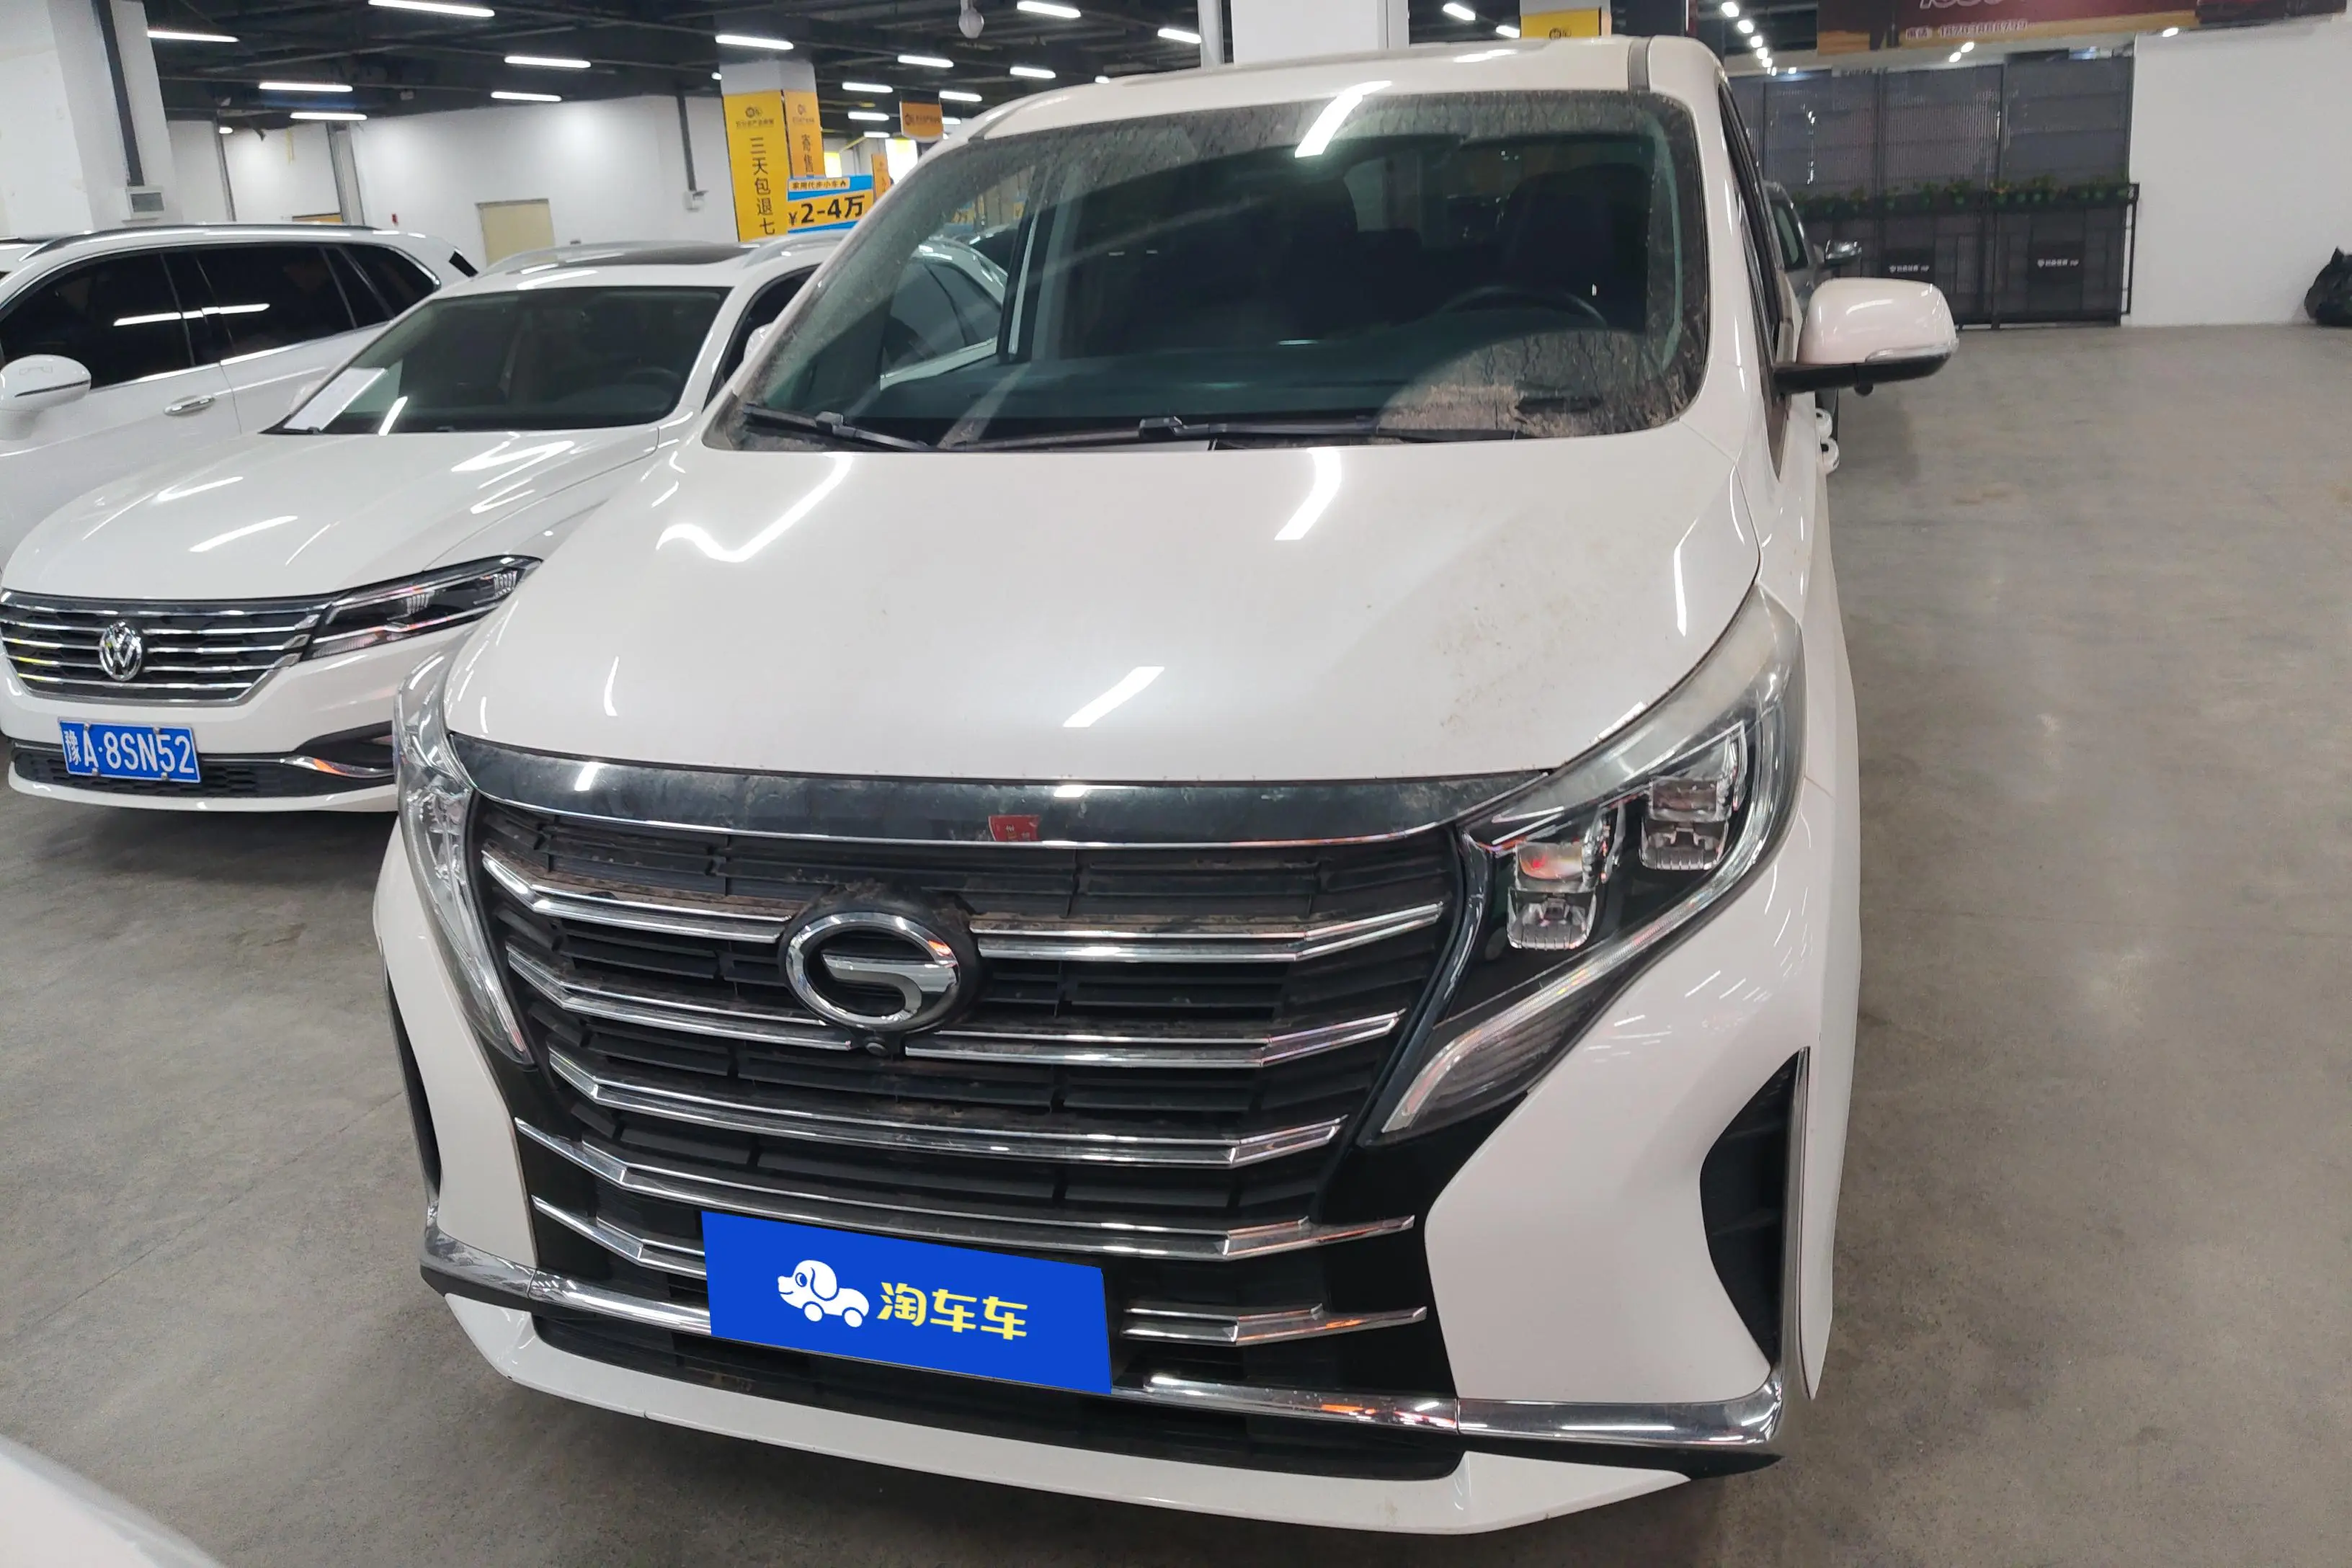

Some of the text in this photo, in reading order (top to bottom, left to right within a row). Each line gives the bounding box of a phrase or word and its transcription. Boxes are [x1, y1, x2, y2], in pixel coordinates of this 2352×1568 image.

[749, 137, 775, 236] 三天包退七
